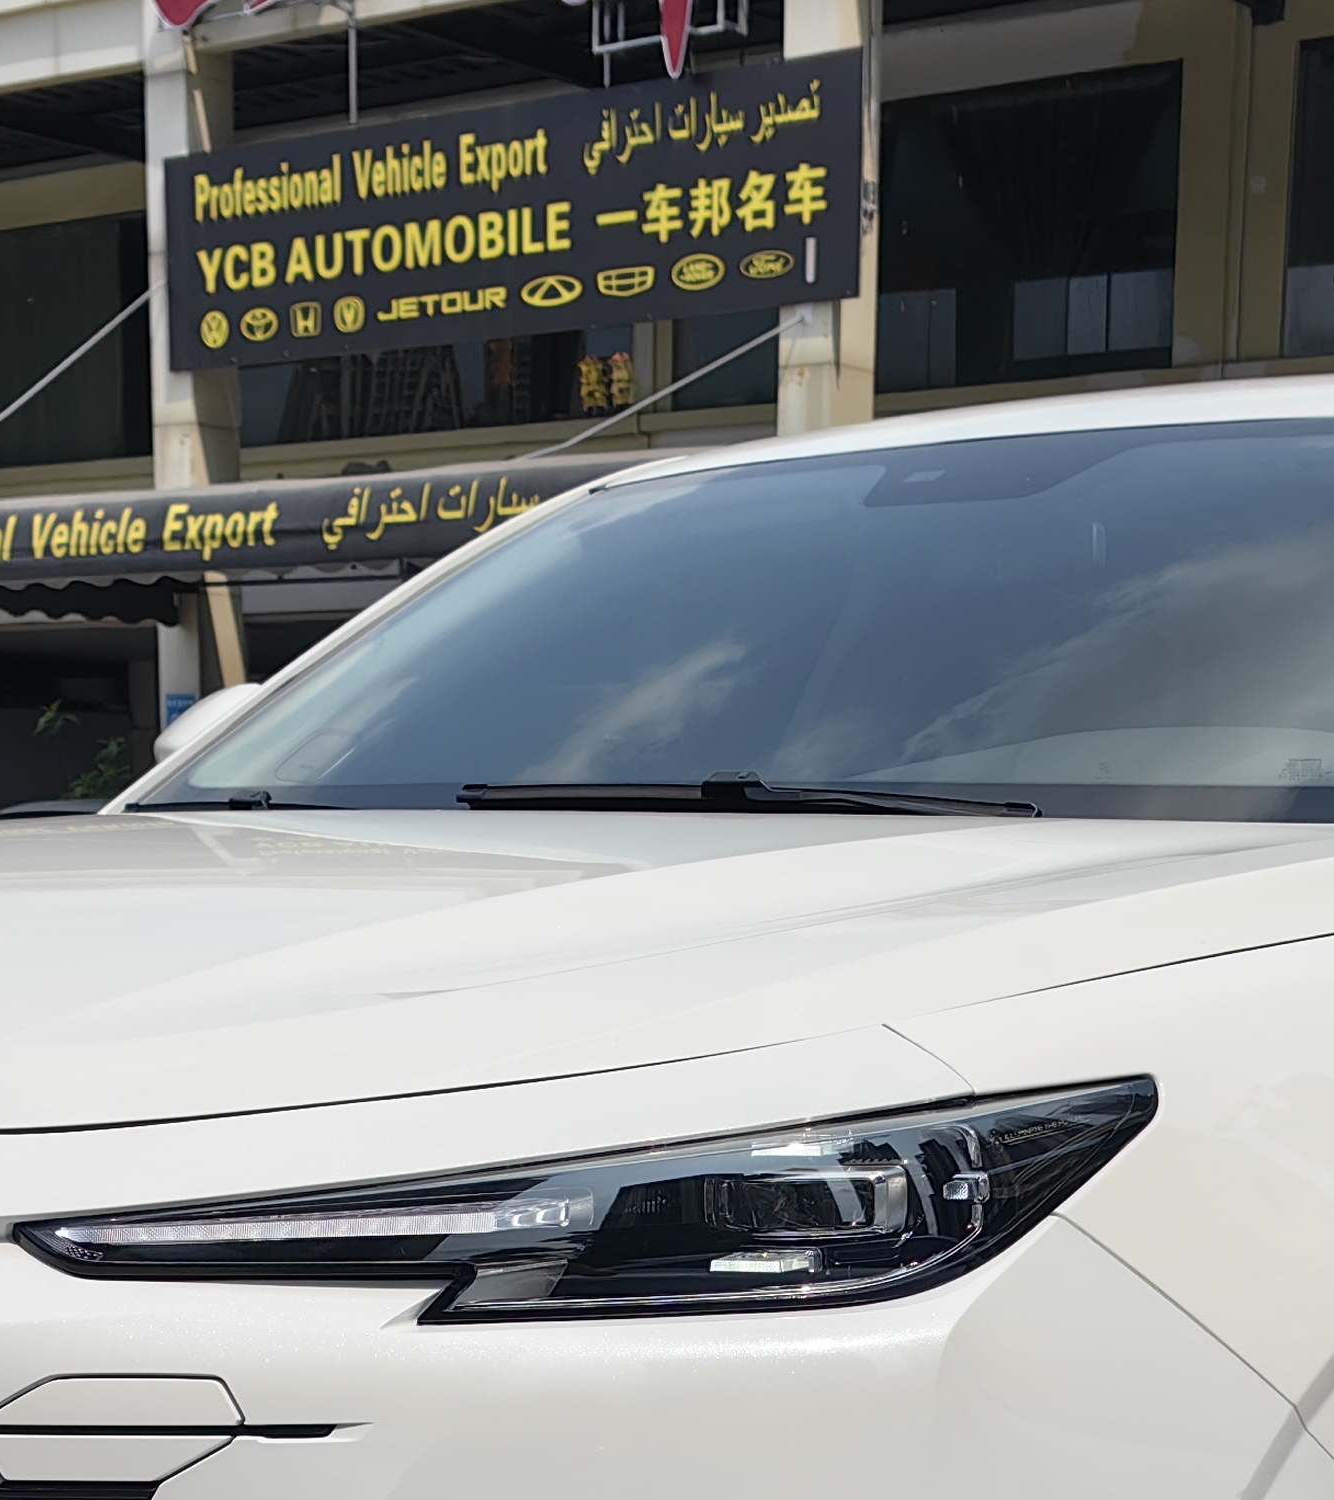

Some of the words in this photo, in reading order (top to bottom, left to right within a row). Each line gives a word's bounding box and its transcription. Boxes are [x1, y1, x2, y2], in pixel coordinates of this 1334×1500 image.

[583, 101, 663, 177] احترافي
[668, 91, 746, 152] سيارات
[193, 153, 342, 224] Professional
[352, 140, 447, 201] Vehicle
[458, 128, 549, 195] Export
[595, 162, 829, 244] 一车邦名车
[196, 241, 277, 295] YCB
[284, 201, 572, 285] AUTOMOBILE
[376, 286, 508, 322] JETOUR
[30, 506, 147, 560] Vehicle
[161, 500, 279, 561] Export
[323, 483, 430, 552] احترافي
